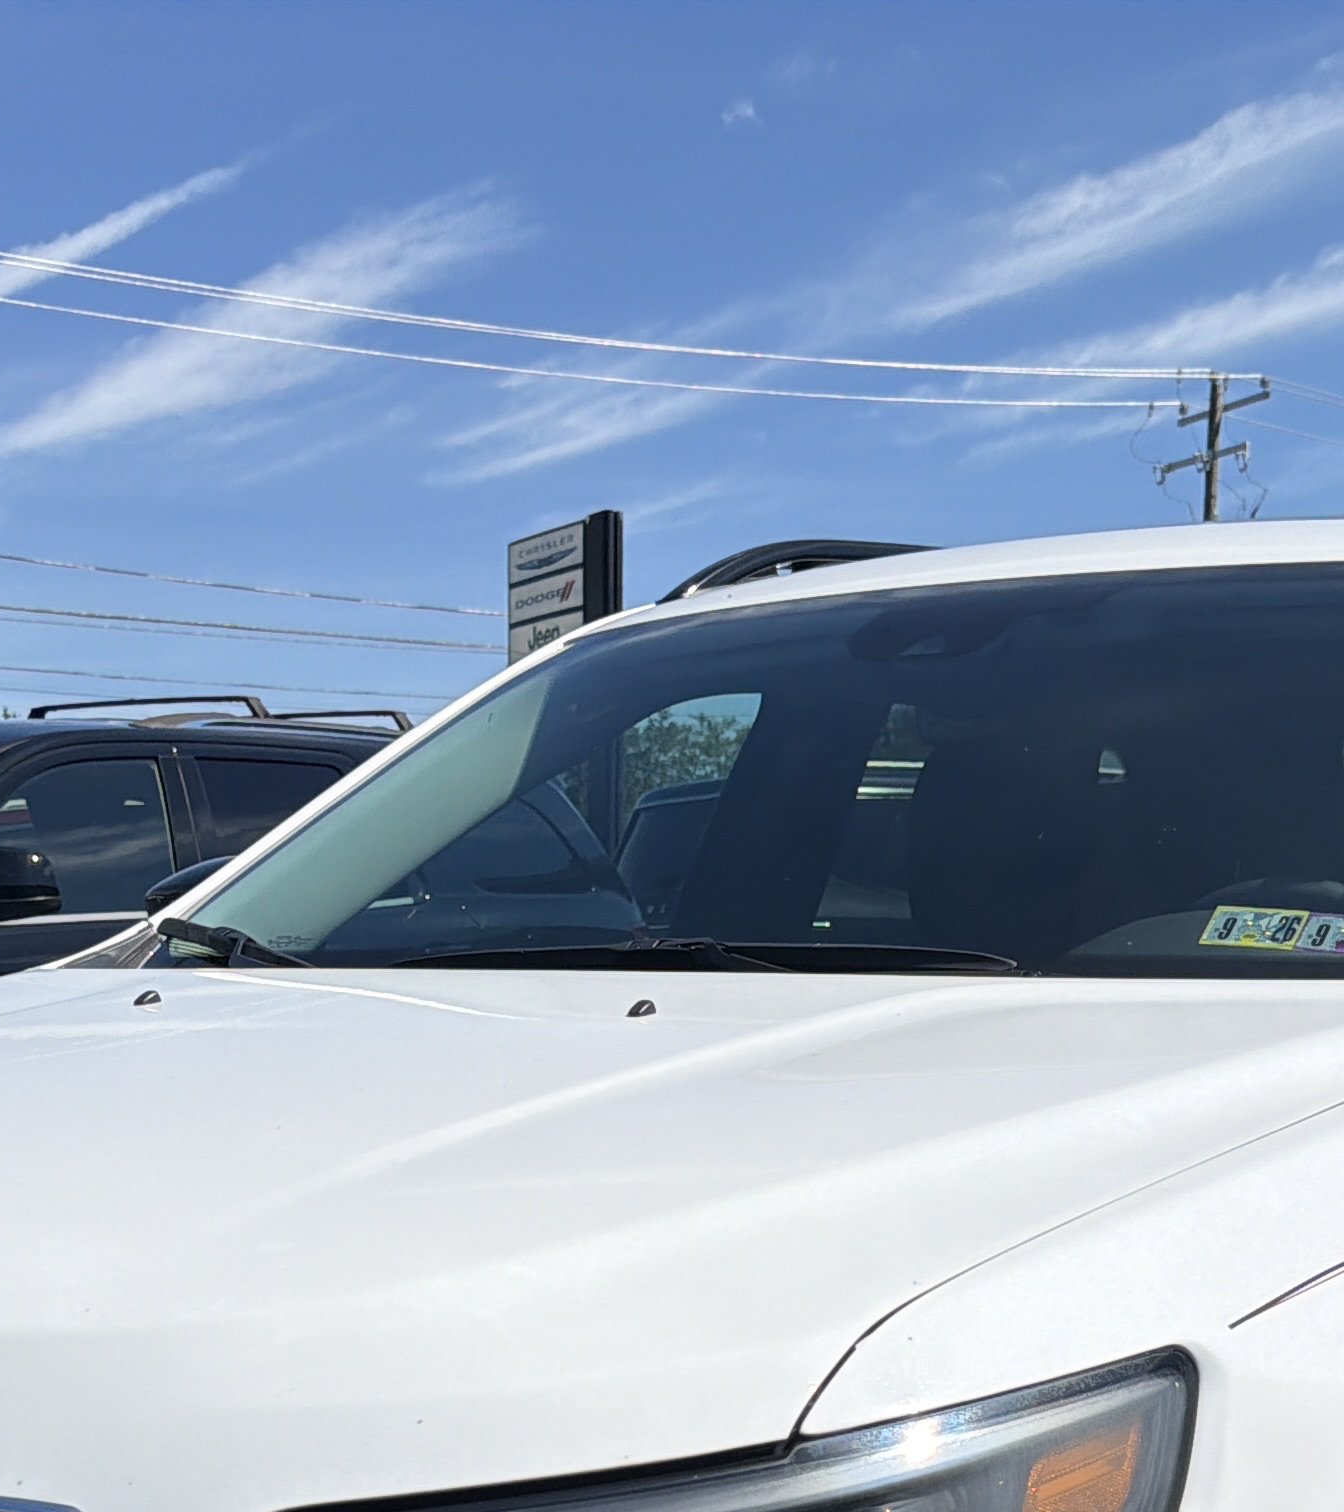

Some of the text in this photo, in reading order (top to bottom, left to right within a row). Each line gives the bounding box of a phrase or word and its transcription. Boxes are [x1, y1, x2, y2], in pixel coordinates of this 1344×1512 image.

[518, 534, 575, 559] CHRYSLER
[515, 589, 564, 610] DODGE
[1217, 916, 1238, 941] 9
[1310, 923, 1331, 947] 9
